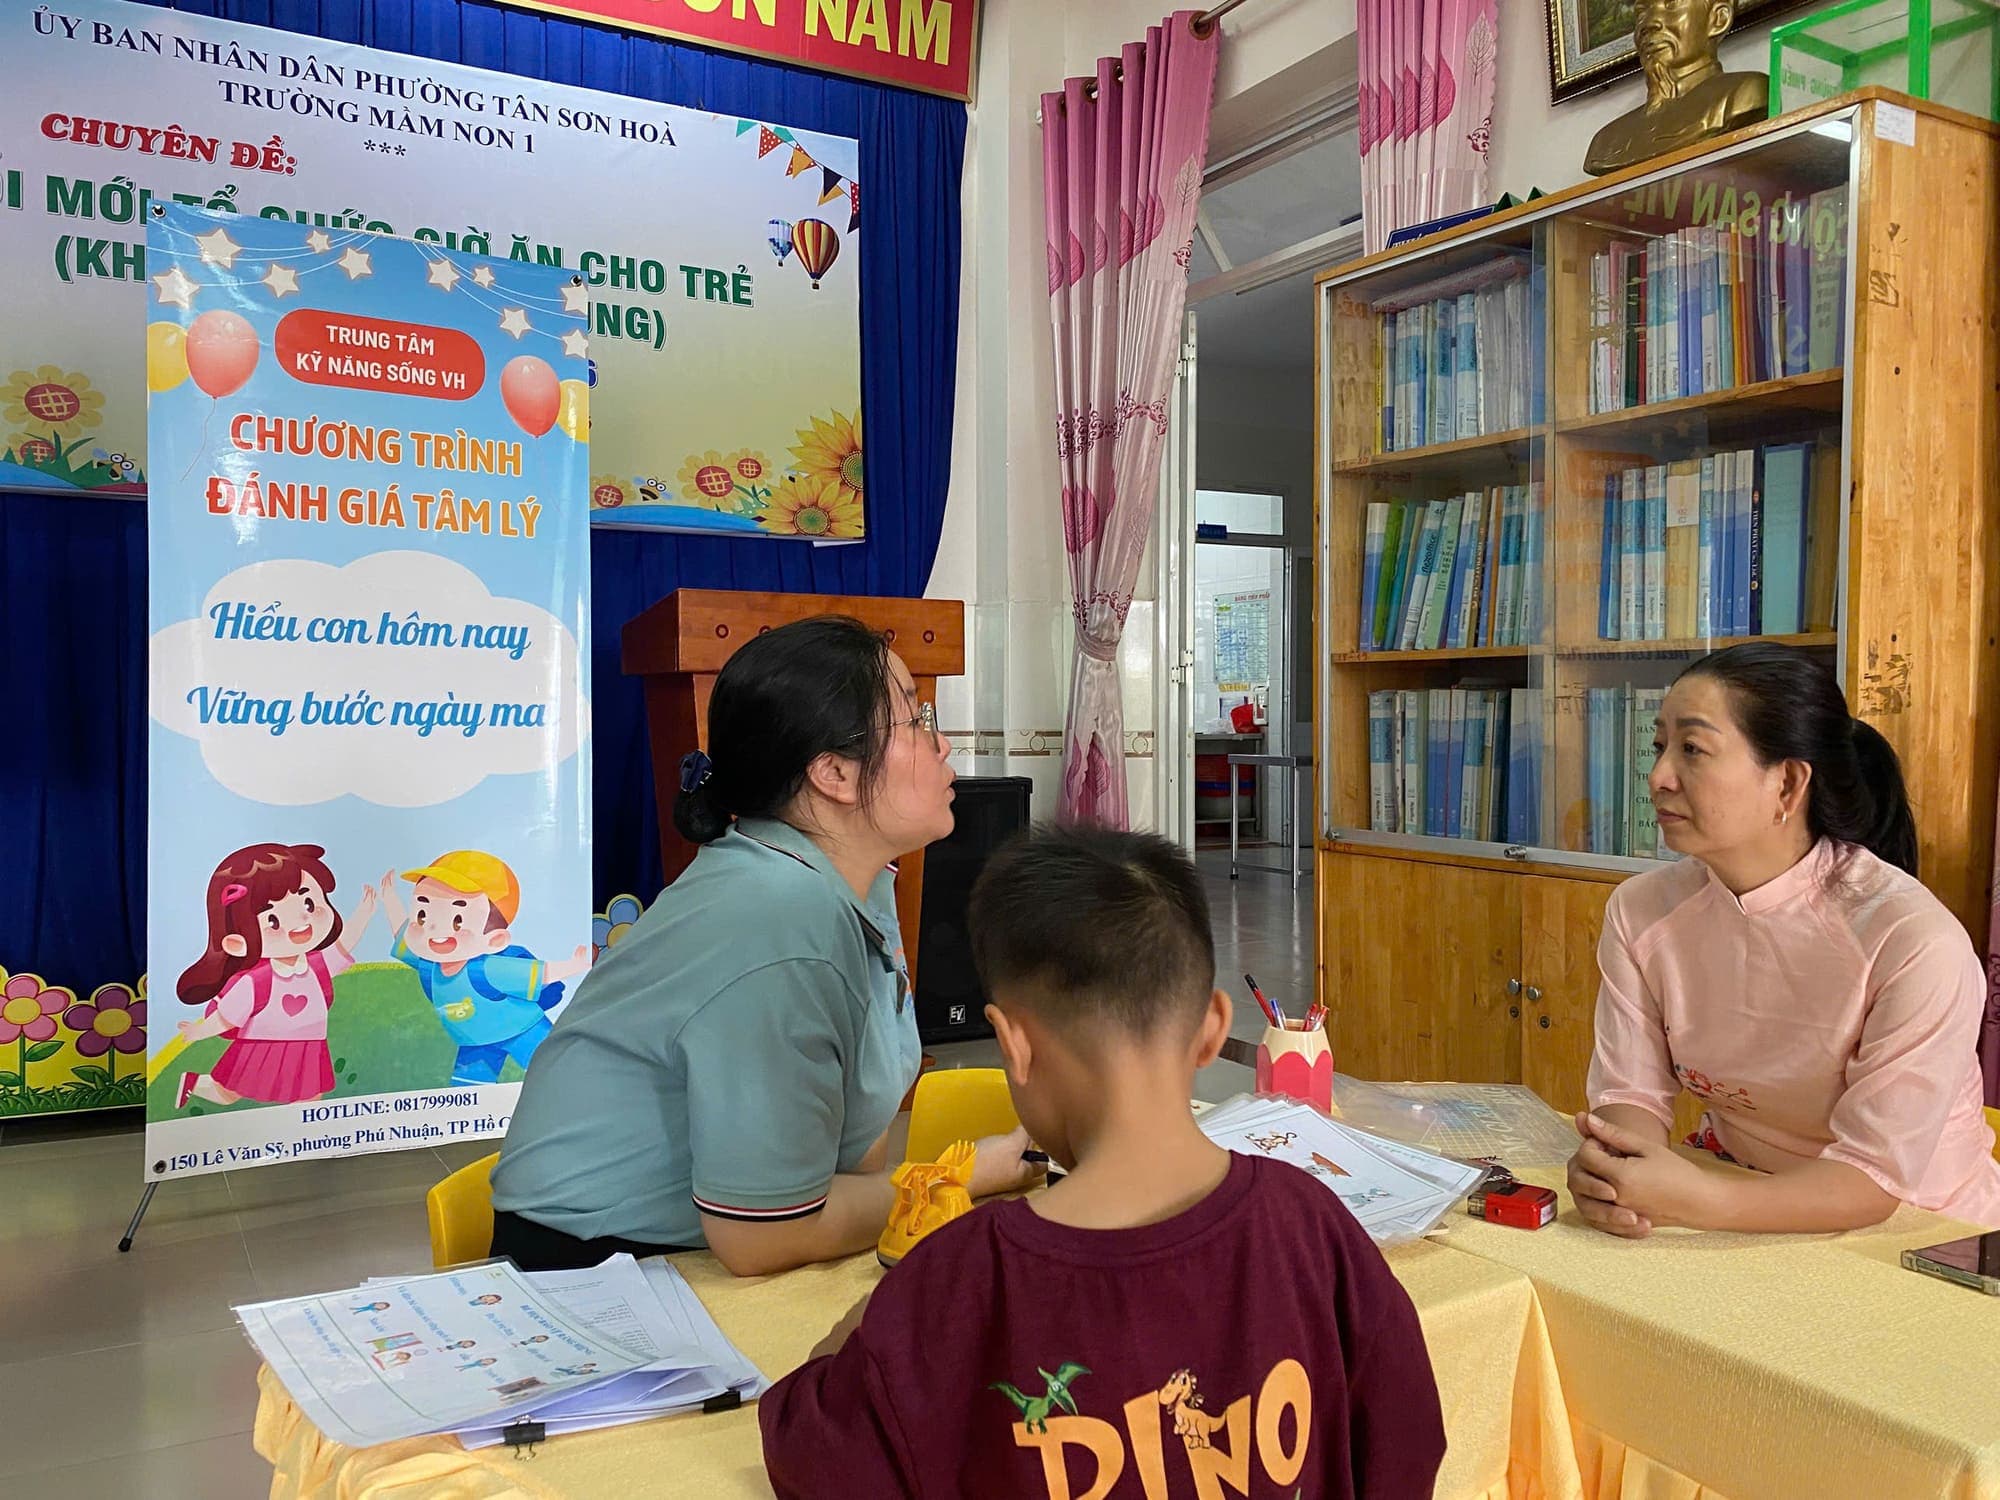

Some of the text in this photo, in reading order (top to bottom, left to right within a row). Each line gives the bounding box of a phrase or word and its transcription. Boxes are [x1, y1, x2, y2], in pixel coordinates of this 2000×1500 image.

[32, 5, 677, 147] ỦY BAN NHÂN DÂN PHƯỜNG TÂN SƠN HOÀ
[40, 112, 298, 176] CHUYÊN ĐỀ:
[218, 79, 359, 124] TRƯỜNG
[452, 119, 515, 149] NON
[522, 132, 535, 154] 1
[46, 174, 154, 226] MỚI
[579, 250, 666, 297] CHO
[679, 263, 755, 307] TRẺ
[54, 235, 147, 284] (KH
[296, 350, 466, 391] KỸ NĂNG SỐNG VH
[325, 325, 435, 356] TRUNG TÂM
[230, 413, 523, 478] CHƯƠNG TRÌNH
[206, 471, 543, 539] ĐÁNH GIÁ TÂM LÝ
[209, 600, 531, 660] Hiểu con hôm nay
[186, 686, 295, 737] Vững
[300, 689, 387, 727] bước
[389, 690, 485, 738] ngày
[302, 1091, 480, 1124] HOTLINE: 0817999081
[170, 1153, 198, 1173] 150
[202, 1145, 224, 1167] Lê
[228, 1144, 262, 1163] Văn
[265, 1139, 290, 1159] Sỹ,
[293, 1131, 352, 1156] phường
[355, 1126, 386, 1144] Phú
[389, 1122, 443, 1141] Nhuận,
[447, 1120, 470, 1135] TP
[474, 1114, 496, 1133] Hồ
[1012, 1358, 1313, 1500] DINO
